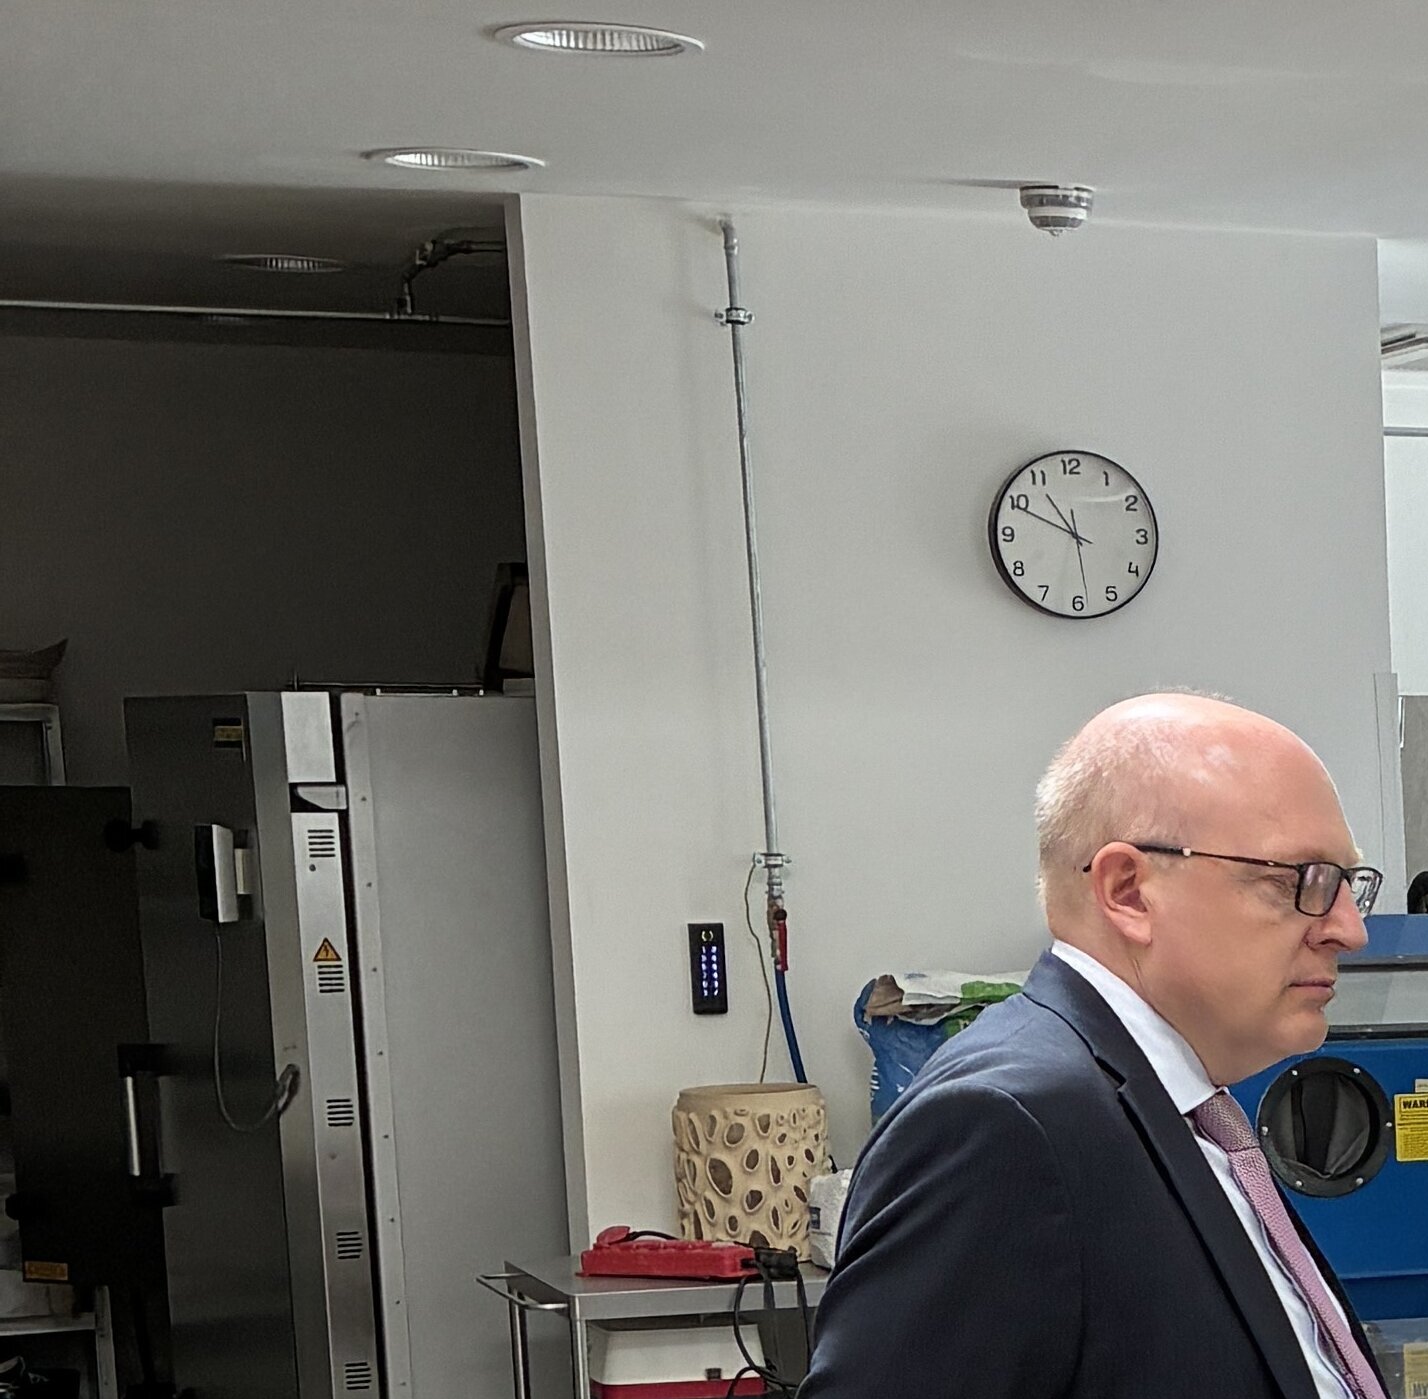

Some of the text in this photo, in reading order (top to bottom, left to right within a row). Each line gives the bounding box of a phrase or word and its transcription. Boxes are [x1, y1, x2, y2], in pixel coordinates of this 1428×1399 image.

[1061, 458, 1081, 475] 12
[1031, 470, 1046, 486] 11
[1103, 471, 1110, 486] 1
[1010, 494, 1029, 511] 10
[1125, 495, 1139, 512] 2
[1001, 526, 1015, 542] 9
[1135, 529, 1149, 545] 3
[1012, 561, 1025, 577] 8
[1128, 562, 1140, 578] 4
[1038, 585, 1050, 601] 7
[1105, 586, 1119, 601] 5
[1072, 596, 1085, 612] 6
